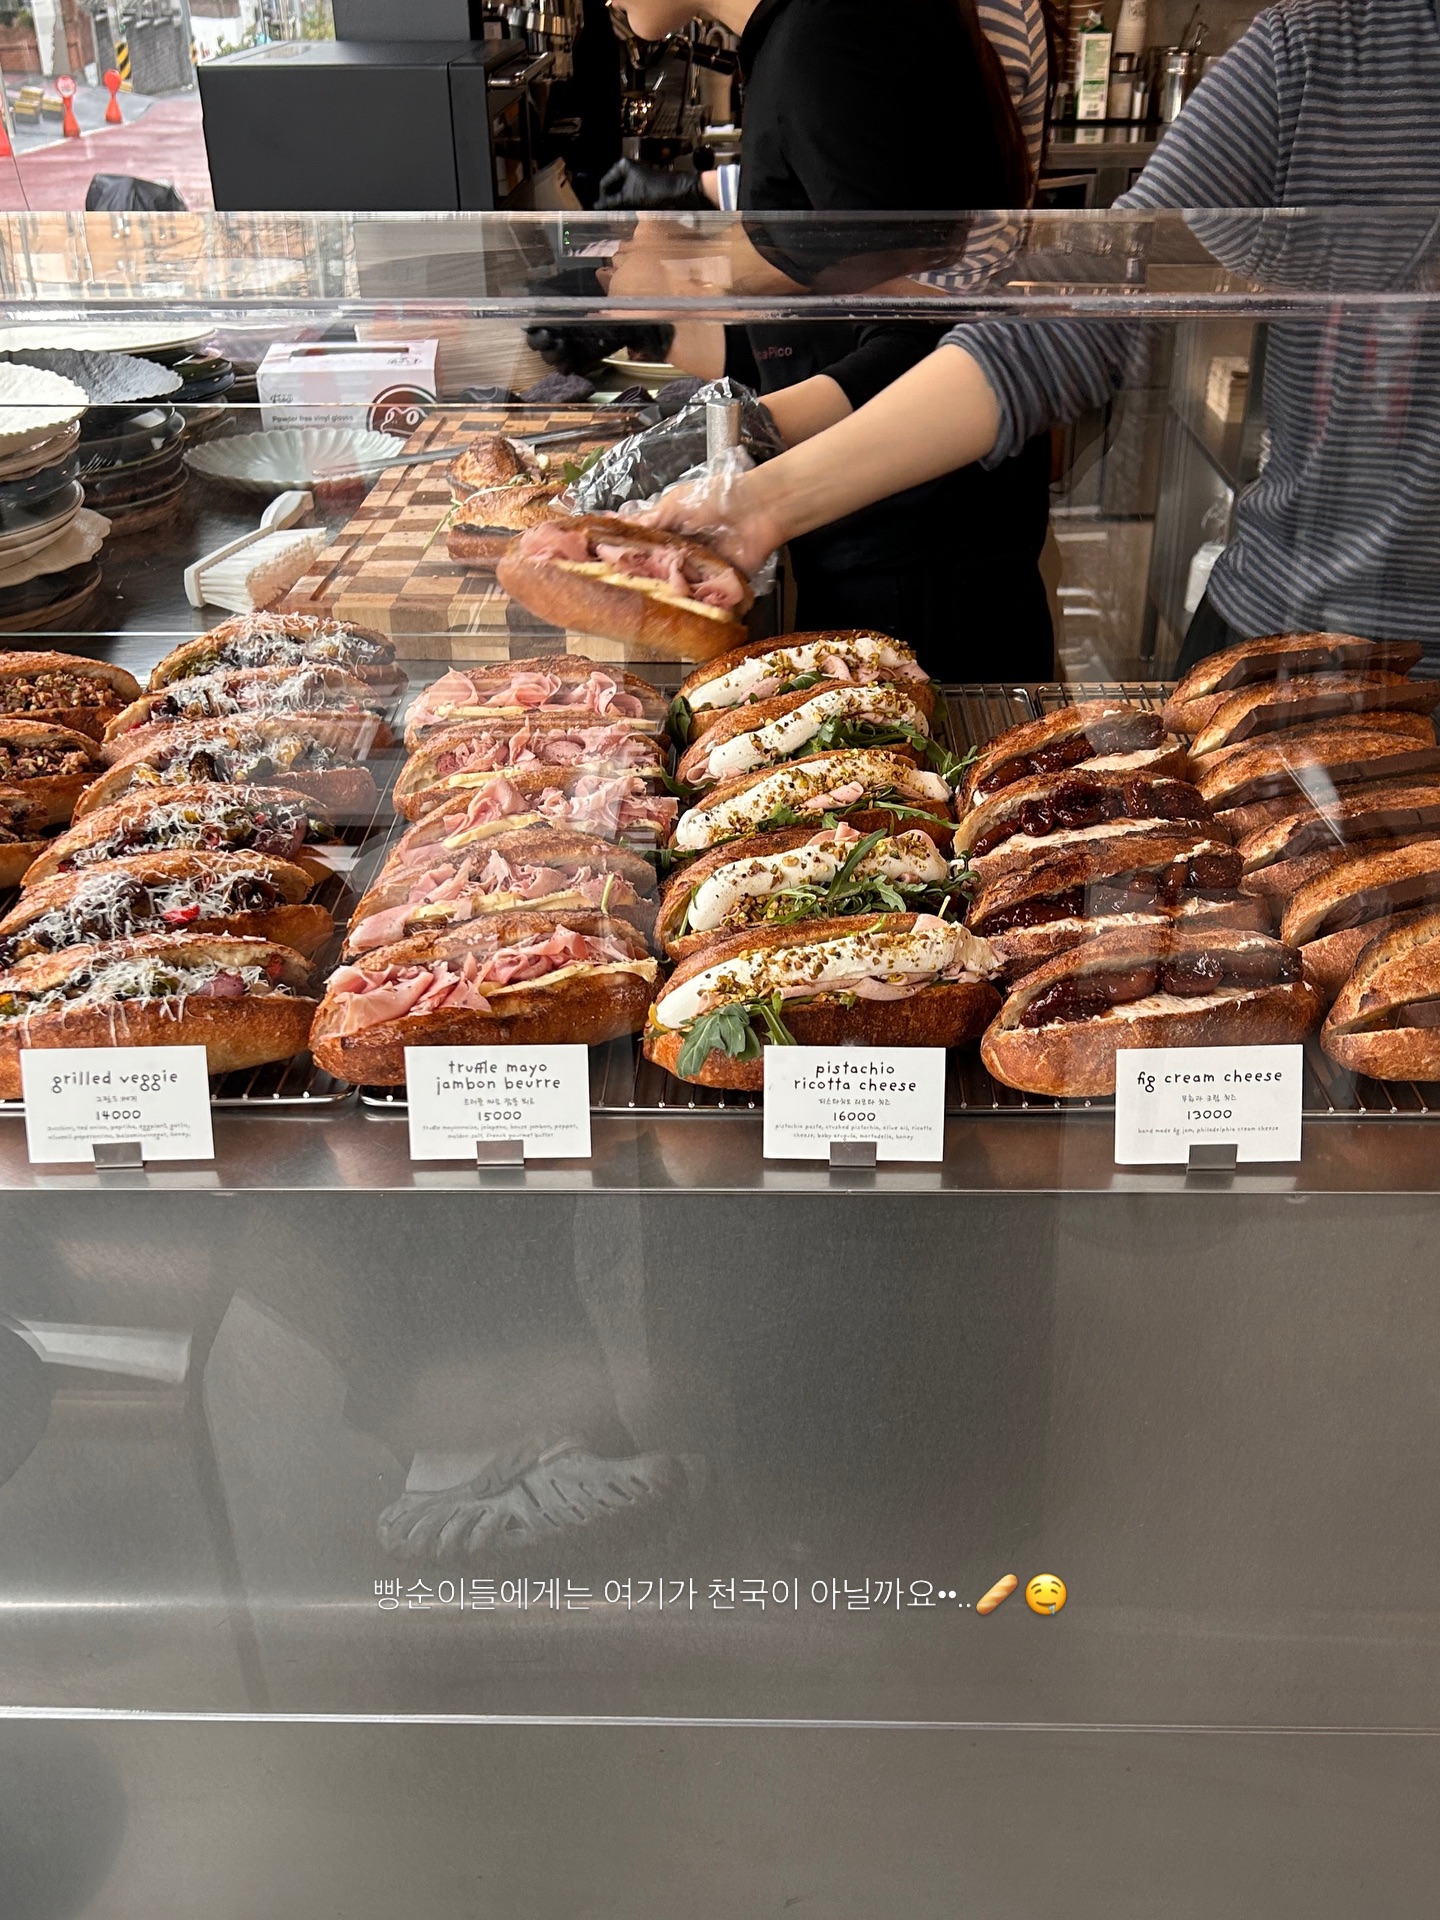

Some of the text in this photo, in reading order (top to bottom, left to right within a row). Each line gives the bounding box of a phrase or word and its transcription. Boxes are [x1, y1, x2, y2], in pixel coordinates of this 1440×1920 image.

[448, 1060, 548, 1078] truffle mayo
[815, 1061, 895, 1078] pistachio
[51, 1070, 178, 1094] grilled veggie
[436, 1077, 561, 1095] jambon beurre
[794, 1077, 917, 1092] ricotta cheese
[1137, 1069, 1283, 1093] fig cream cheese
[818, 1097, 851, 1106] 피스타치오
[878, 1098, 891, 1106] 치즈
[1181, 1094, 1203, 1102] 무화과
[1206, 1094, 1220, 1102] 크림
[95, 1110, 141, 1120] 14000
[478, 1111, 522, 1121] 15000
[833, 1111, 876, 1122] 16000
[1187, 1110, 1232, 1120] 13000
